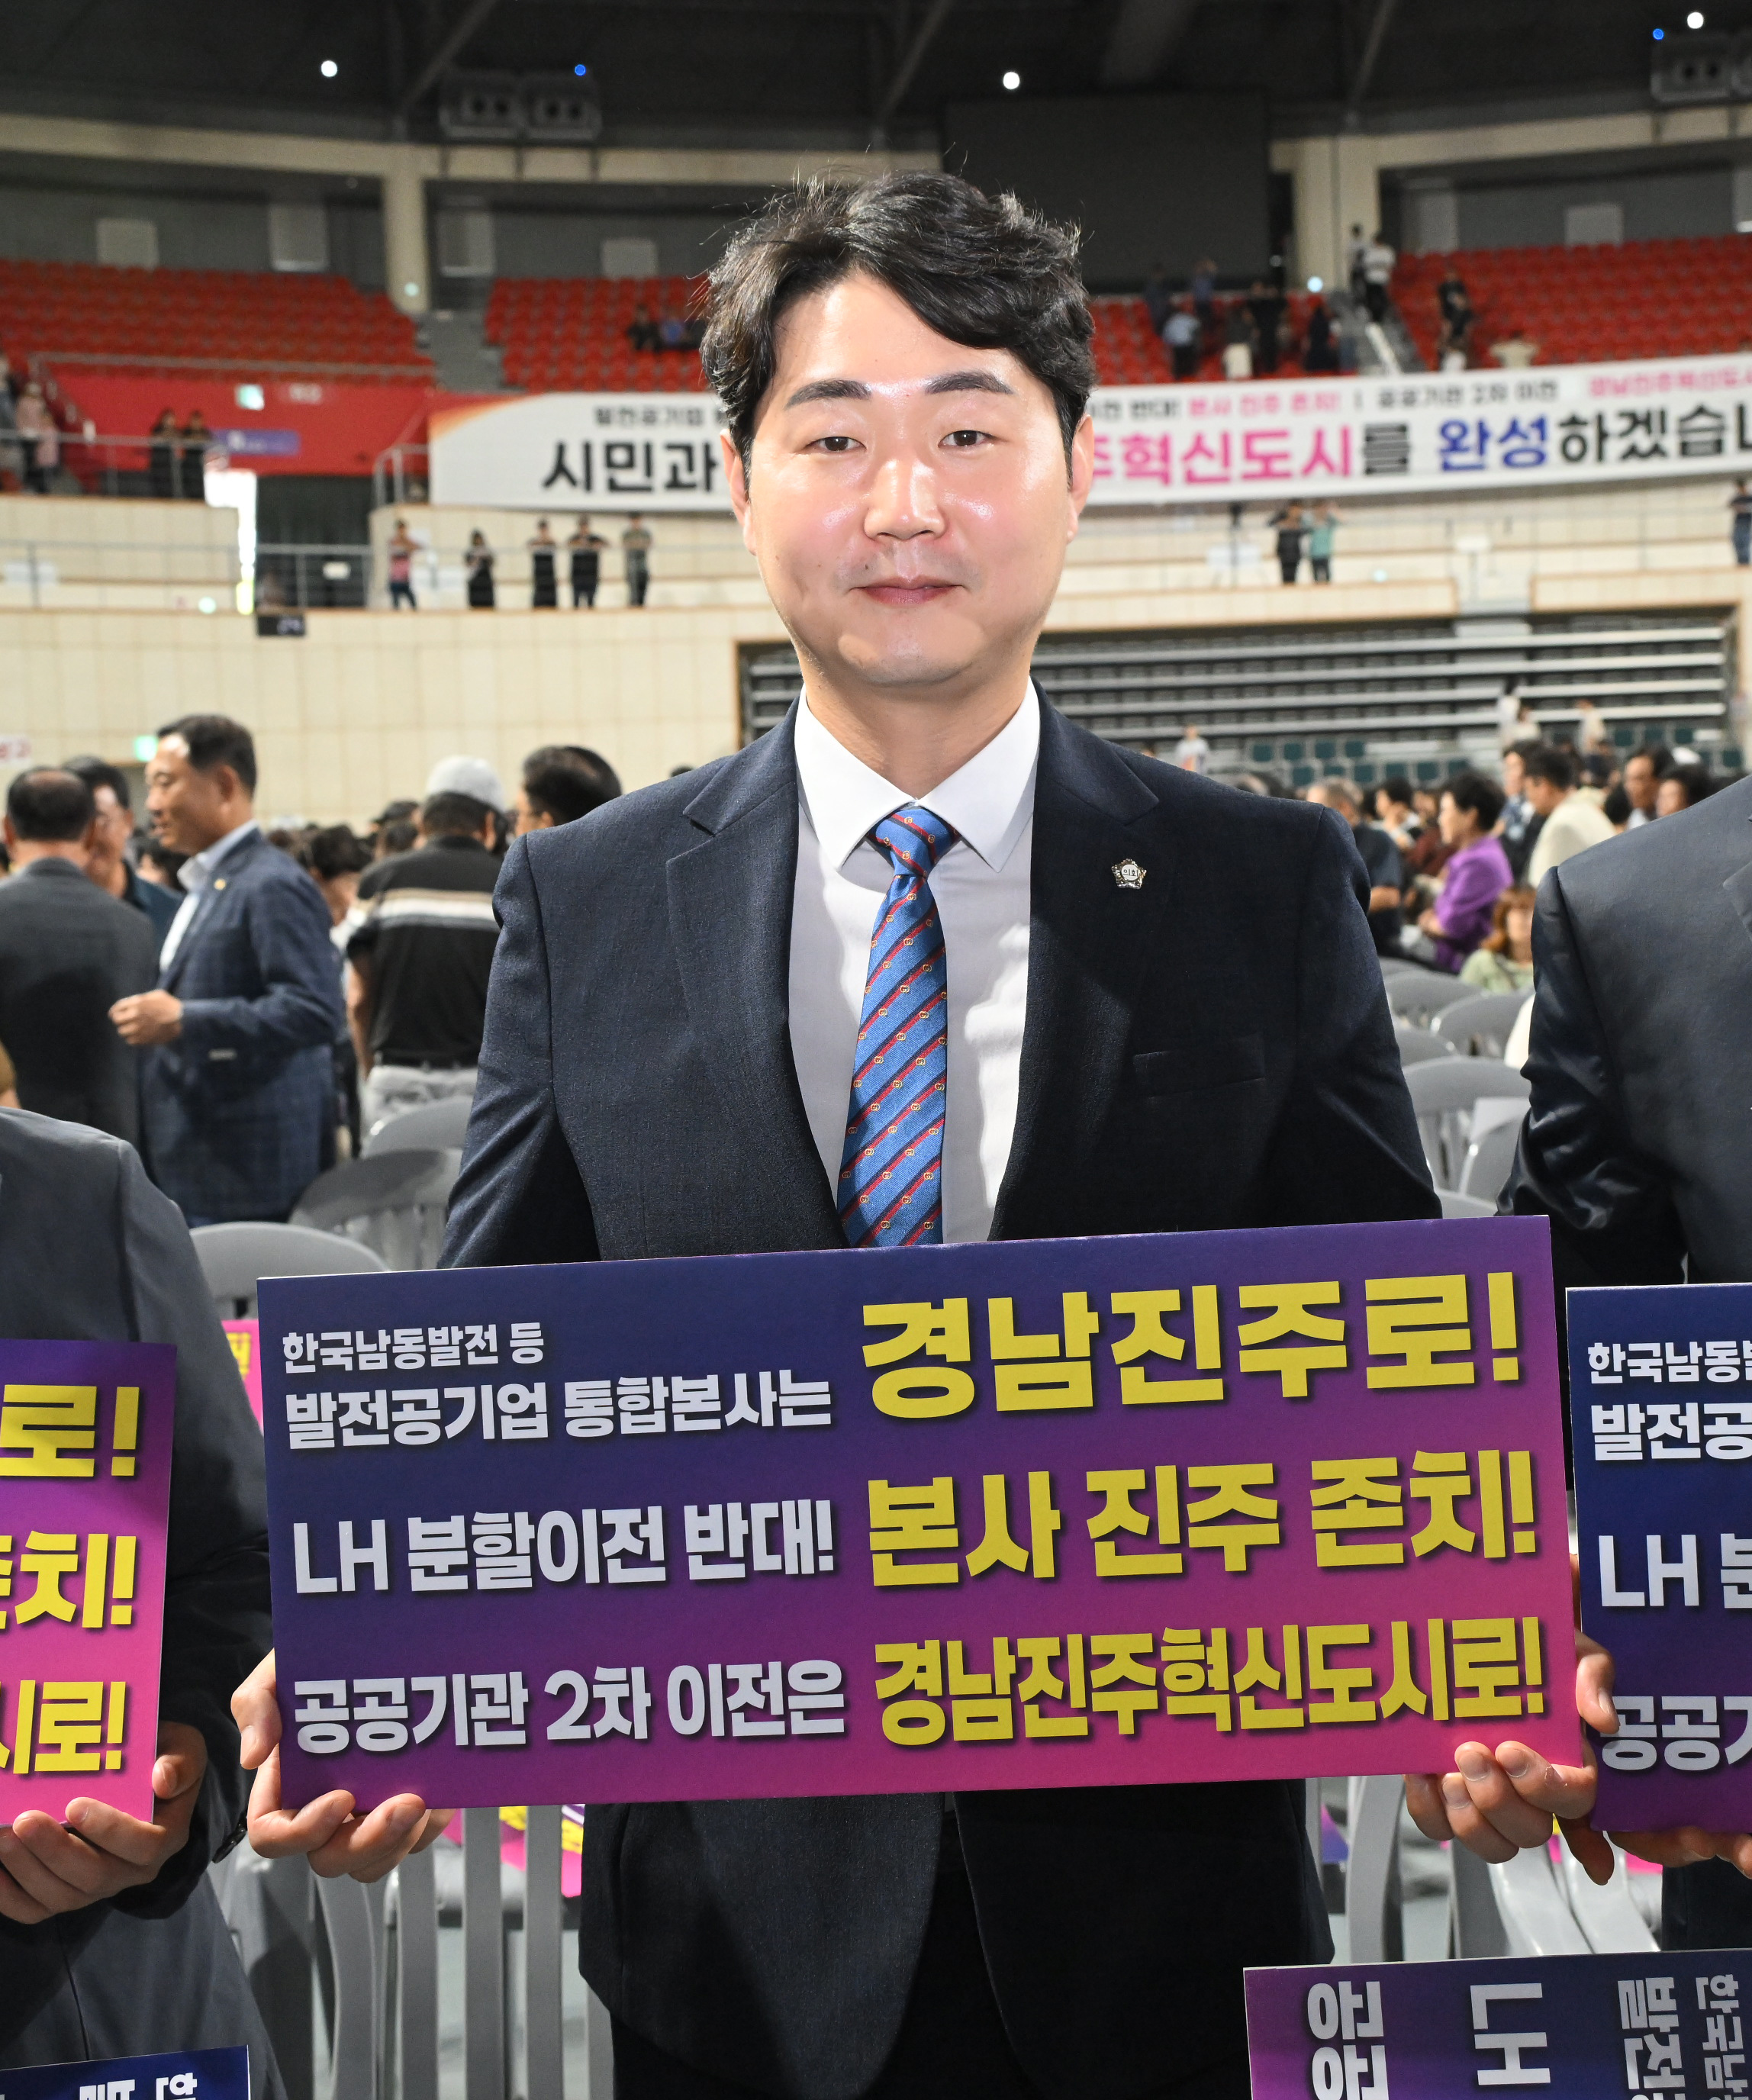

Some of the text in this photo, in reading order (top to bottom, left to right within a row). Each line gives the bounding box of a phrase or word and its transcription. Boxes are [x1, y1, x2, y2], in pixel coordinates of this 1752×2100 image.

[543, 440, 719, 493] 시민과
[283, 1324, 498, 1374] 한국남동발전
[510, 1322, 544, 1364] 등
[286, 1272, 1519, 1449] 발전공기업 통합본사는 경남진주로!
[1588, 1341, 1752, 1384] 한국남동
[294, 1450, 1536, 1593] LH 분할이전 반대! 본사 진주 존치!
[0, 1531, 136, 1628] 치!
[1599, 1535, 1699, 1606] LH
[295, 1616, 1544, 1754] 공공기관 2차 이전은 경남진주혁신도시로!
[1470, 1983, 1551, 2086] LH
